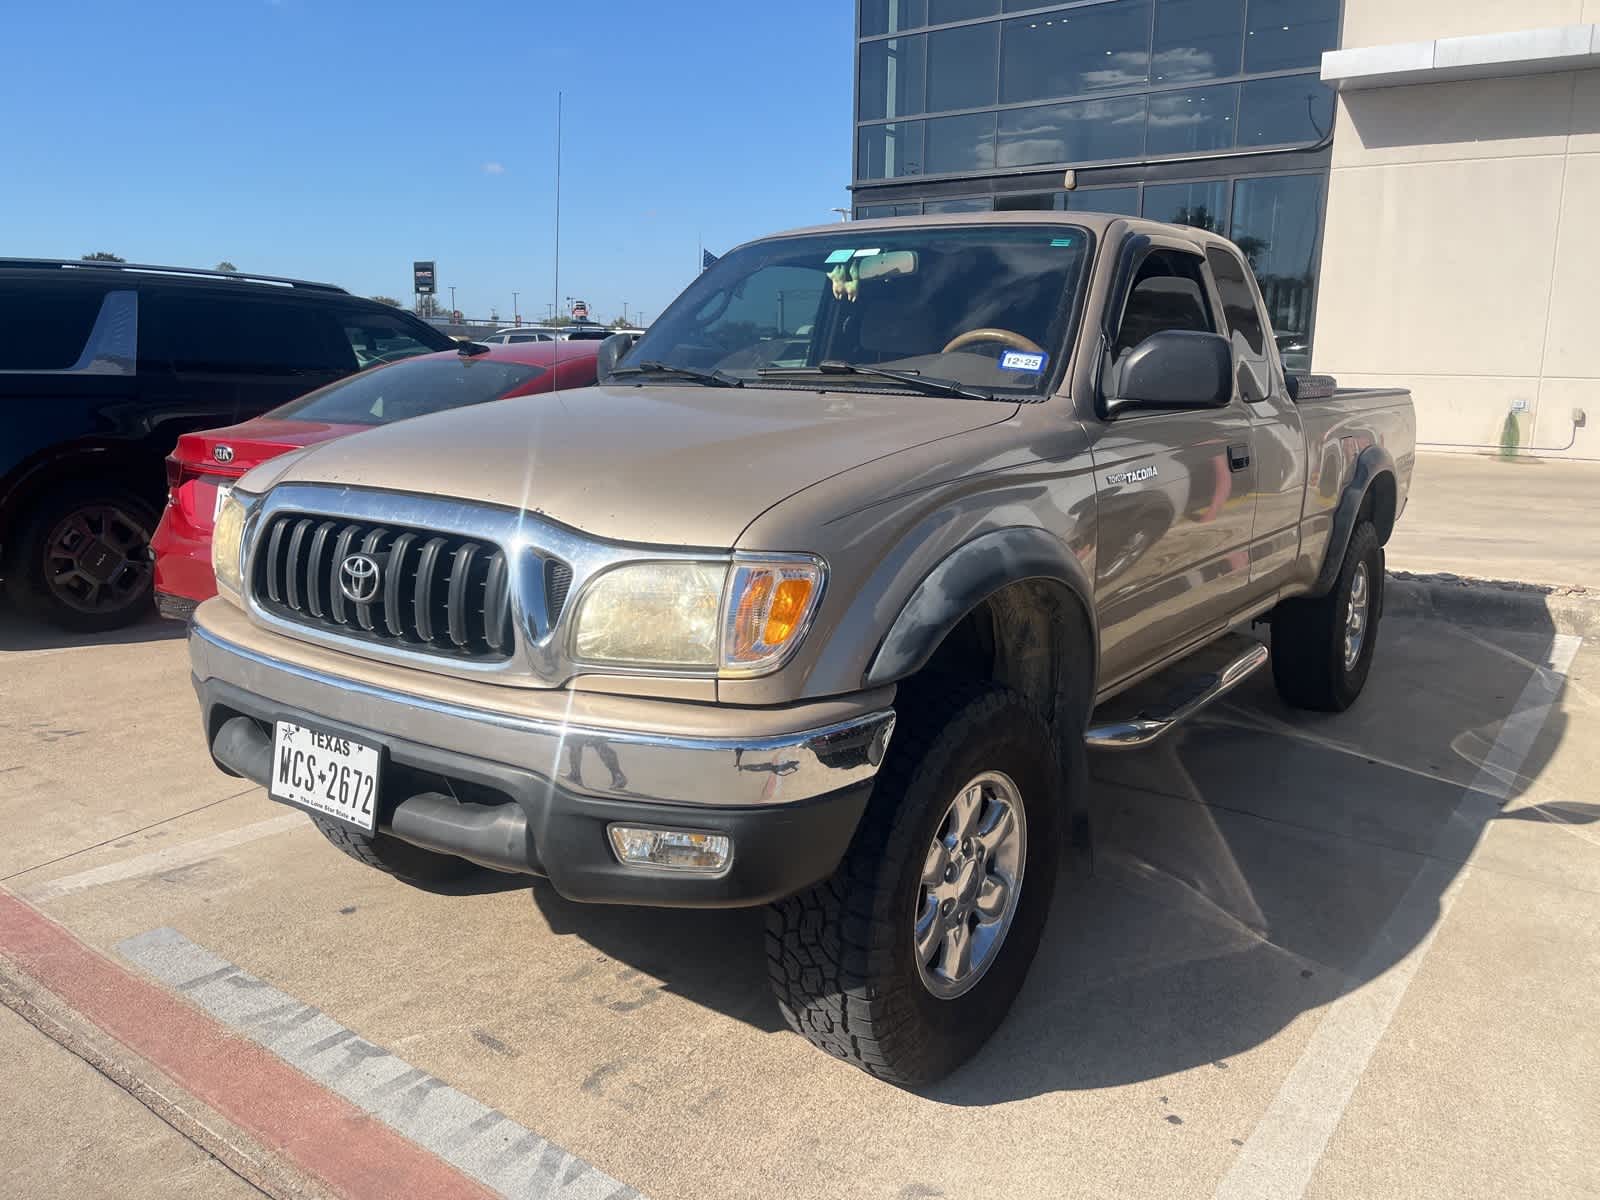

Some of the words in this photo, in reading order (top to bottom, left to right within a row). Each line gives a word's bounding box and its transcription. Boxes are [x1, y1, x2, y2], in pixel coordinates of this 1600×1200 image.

[1126, 465, 1158, 483] TACOMA
[311, 730, 350, 756] TEXAS
[311, 800, 324, 808] Lone
[324, 805, 336, 813] Star
[336, 809, 349, 818] State
